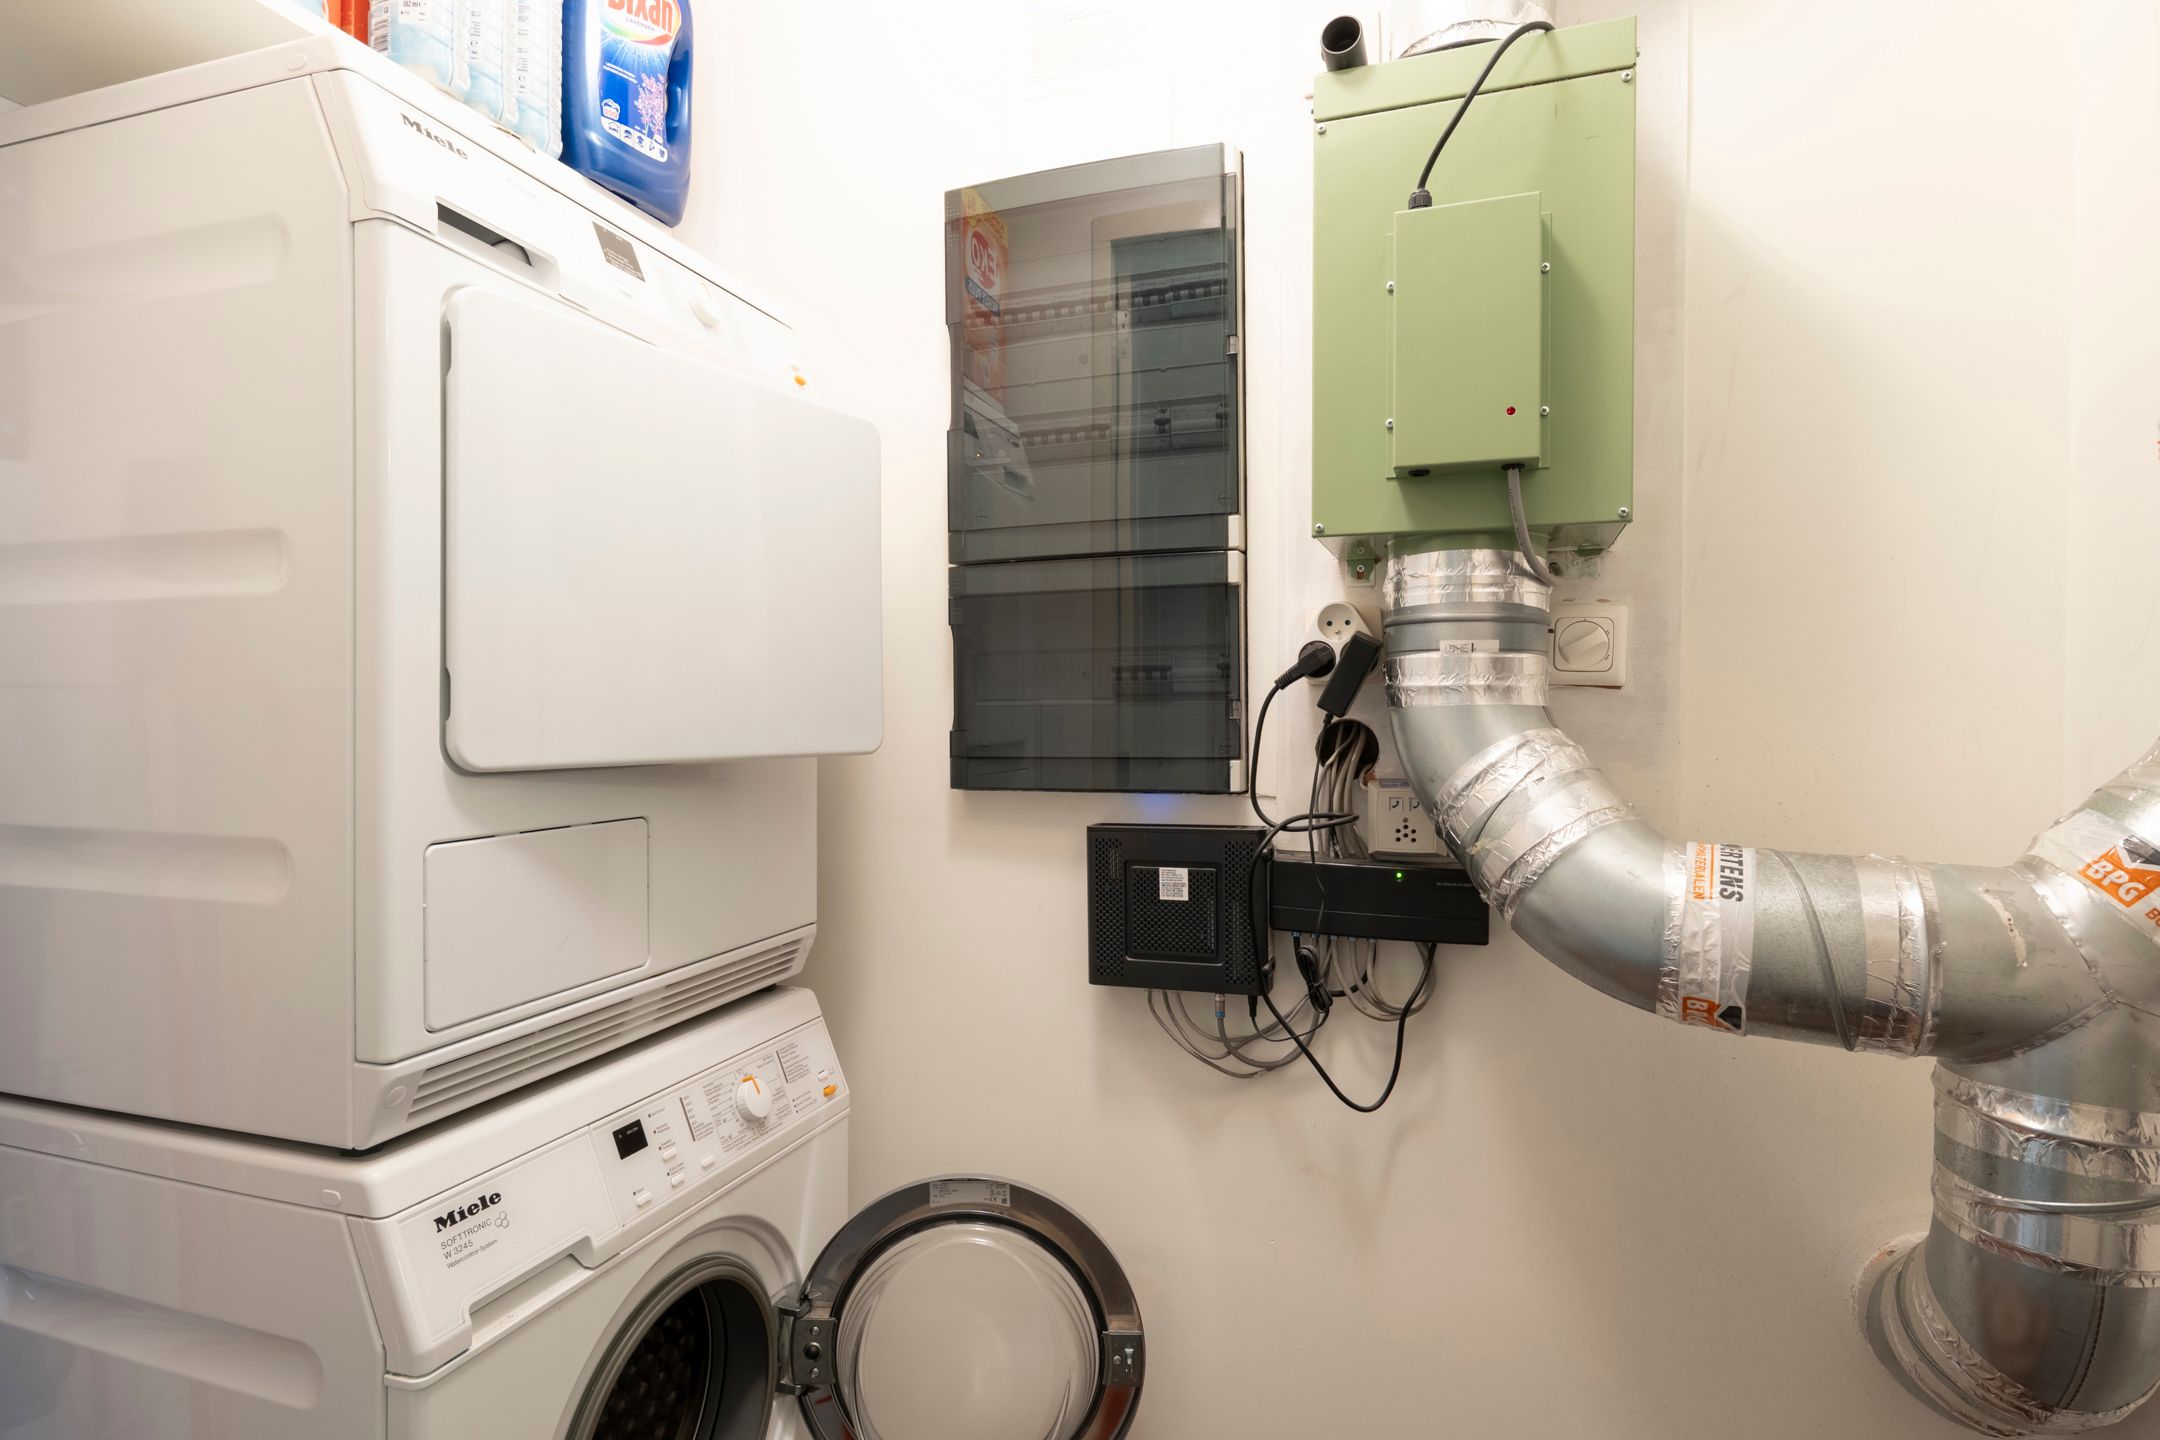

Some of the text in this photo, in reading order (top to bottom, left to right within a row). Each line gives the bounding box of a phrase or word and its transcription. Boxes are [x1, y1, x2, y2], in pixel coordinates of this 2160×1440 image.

[400, 112, 468, 160] Miele
[2084, 860, 2146, 902] BPG
[433, 1192, 502, 1233] Miele
[440, 1218, 492, 1250] SOFTTRONIC
[443, 1239, 473, 1260] W 3245
